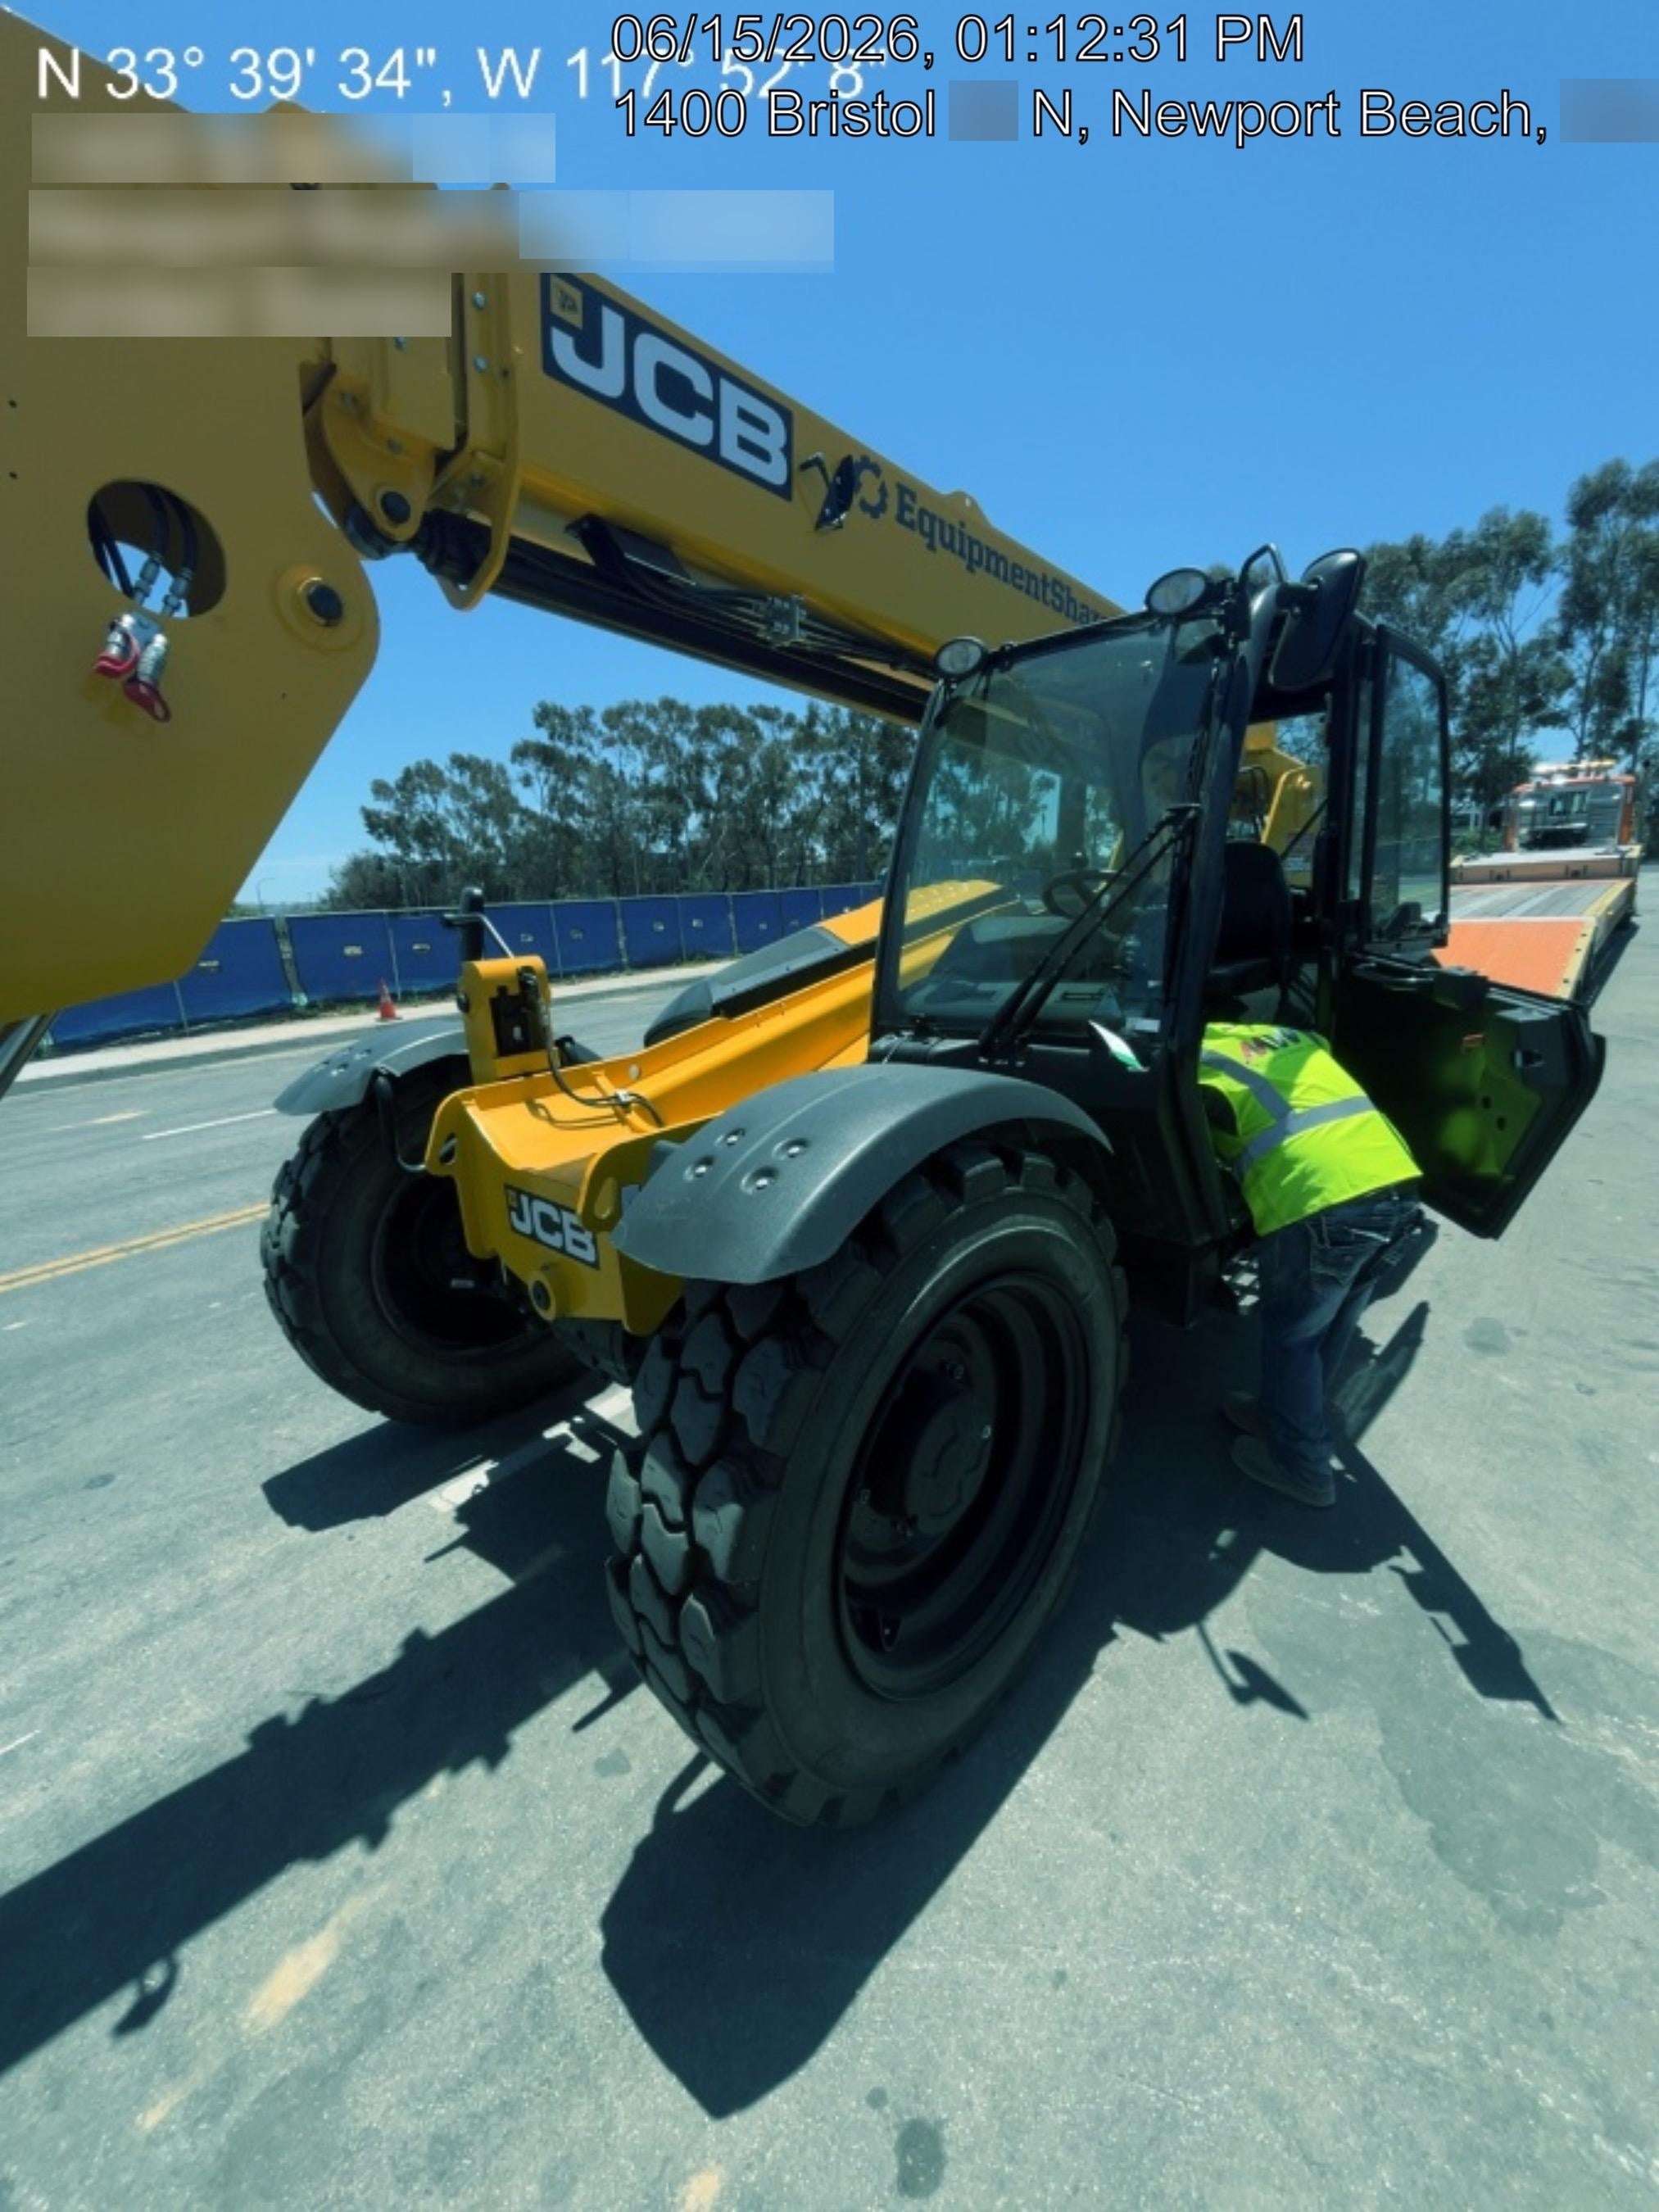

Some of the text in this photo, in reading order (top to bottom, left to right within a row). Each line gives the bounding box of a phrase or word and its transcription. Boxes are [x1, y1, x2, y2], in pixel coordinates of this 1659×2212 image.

[550, 303, 789, 487] JCB
[895, 481, 1103, 625] EquipmentShar
[510, 1194, 596, 1262] JCB
